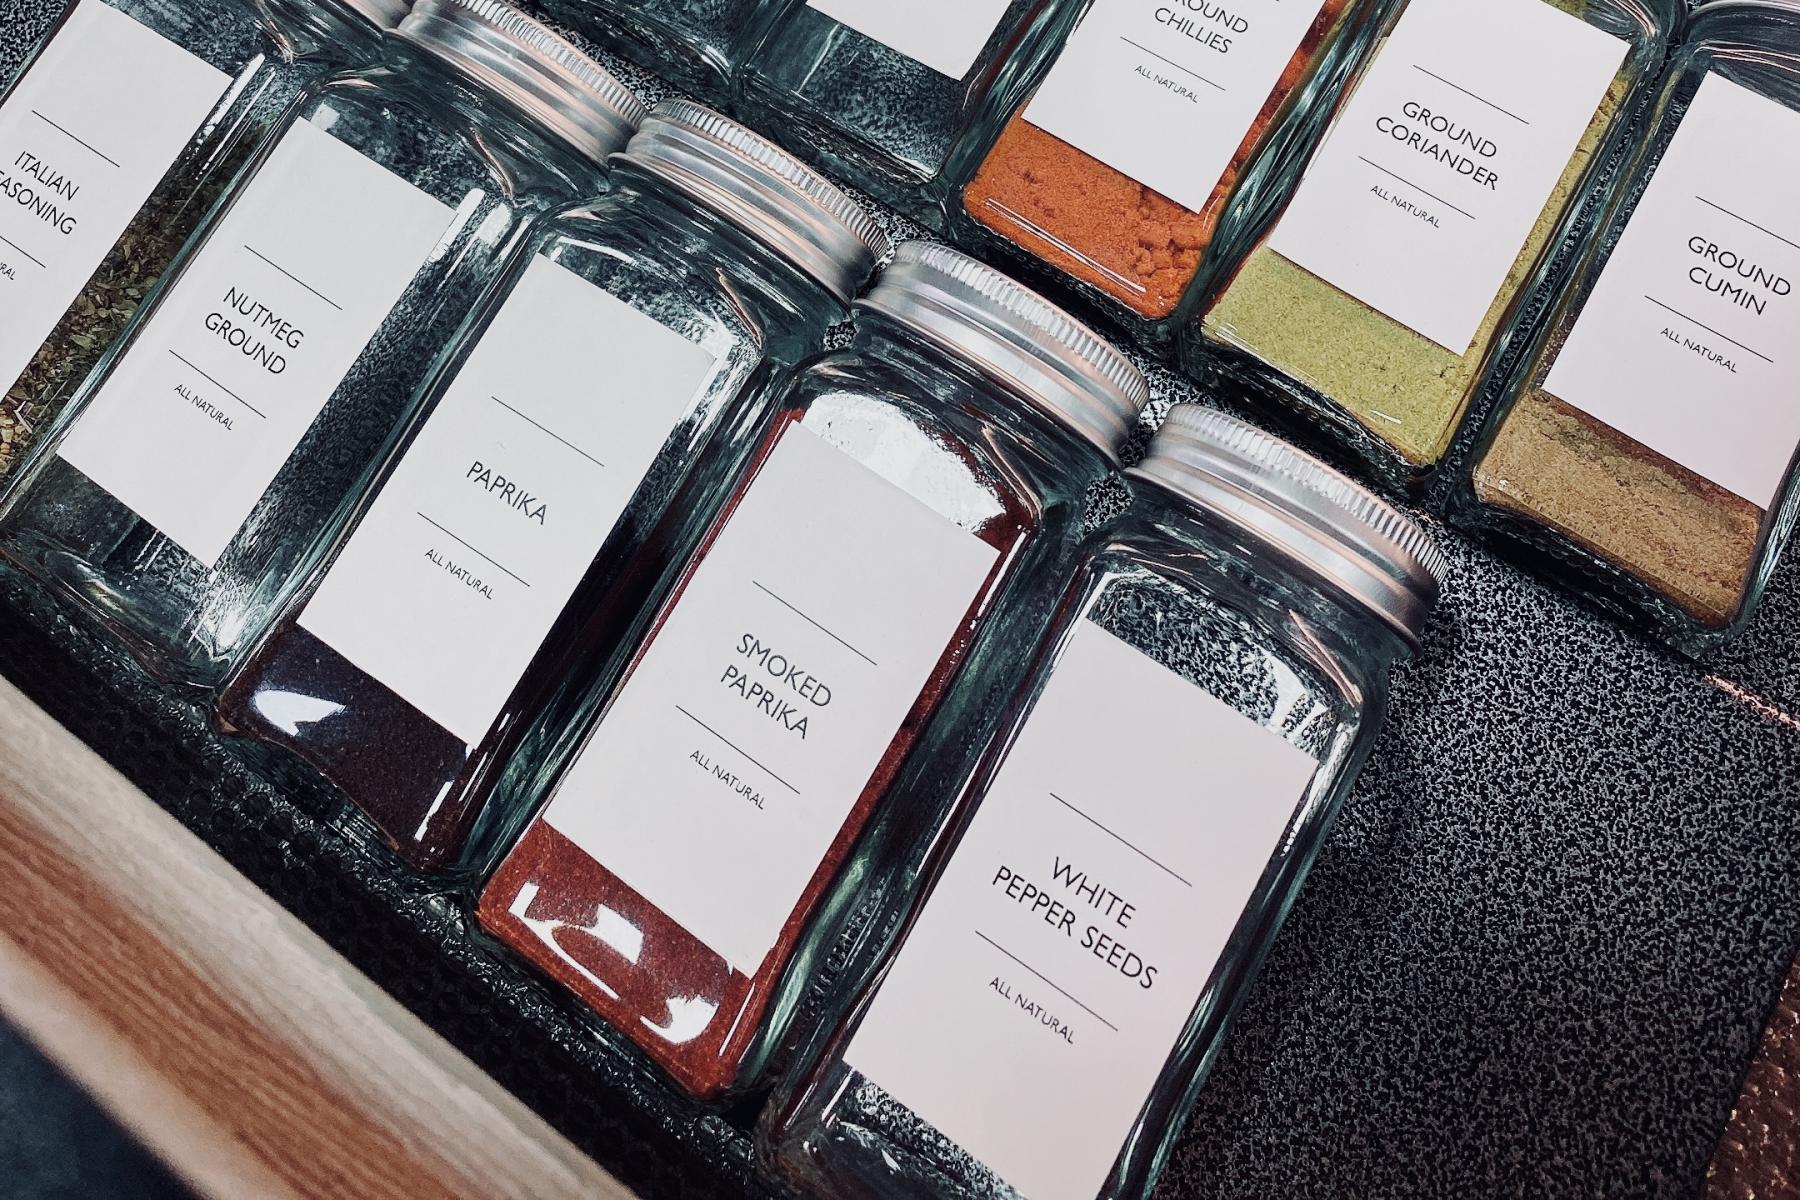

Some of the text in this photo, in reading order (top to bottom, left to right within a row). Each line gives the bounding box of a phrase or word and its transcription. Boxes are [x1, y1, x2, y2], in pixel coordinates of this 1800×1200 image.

[1154, 7, 1233, 54] CHILLIES
[1133, 65, 1198, 104] ALL NATURAL
[1375, 116, 1499, 191] CORIANDER
[1402, 101, 1497, 158] GROUND
[0, 171, 77, 235] ASONING
[14, 150, 80, 201] ITALIAN
[1369, 185, 1440, 229] ALL NATURAL
[1688, 236, 1791, 296] GROUND
[1688, 266, 1767, 316] CUMIN
[205, 312, 286, 375] GROUND
[223, 286, 305, 349] NUTMEG
[1660, 327, 1737, 374] ALL NATURAL
[173, 384, 233, 431] ALL NATURAL
[466, 460, 547, 526] PAPRIKA
[424, 548, 493, 600] ALL NATURAL
[736, 633, 832, 707] SMOKED
[720, 664, 808, 740] PAPRIKA
[689, 750, 765, 810] ALL NATURAL
[1052, 855, 1137, 929] WHITE
[992, 865, 1158, 990] PEPPER SEEDS
[988, 976, 1074, 1045] ALL NATURAL
